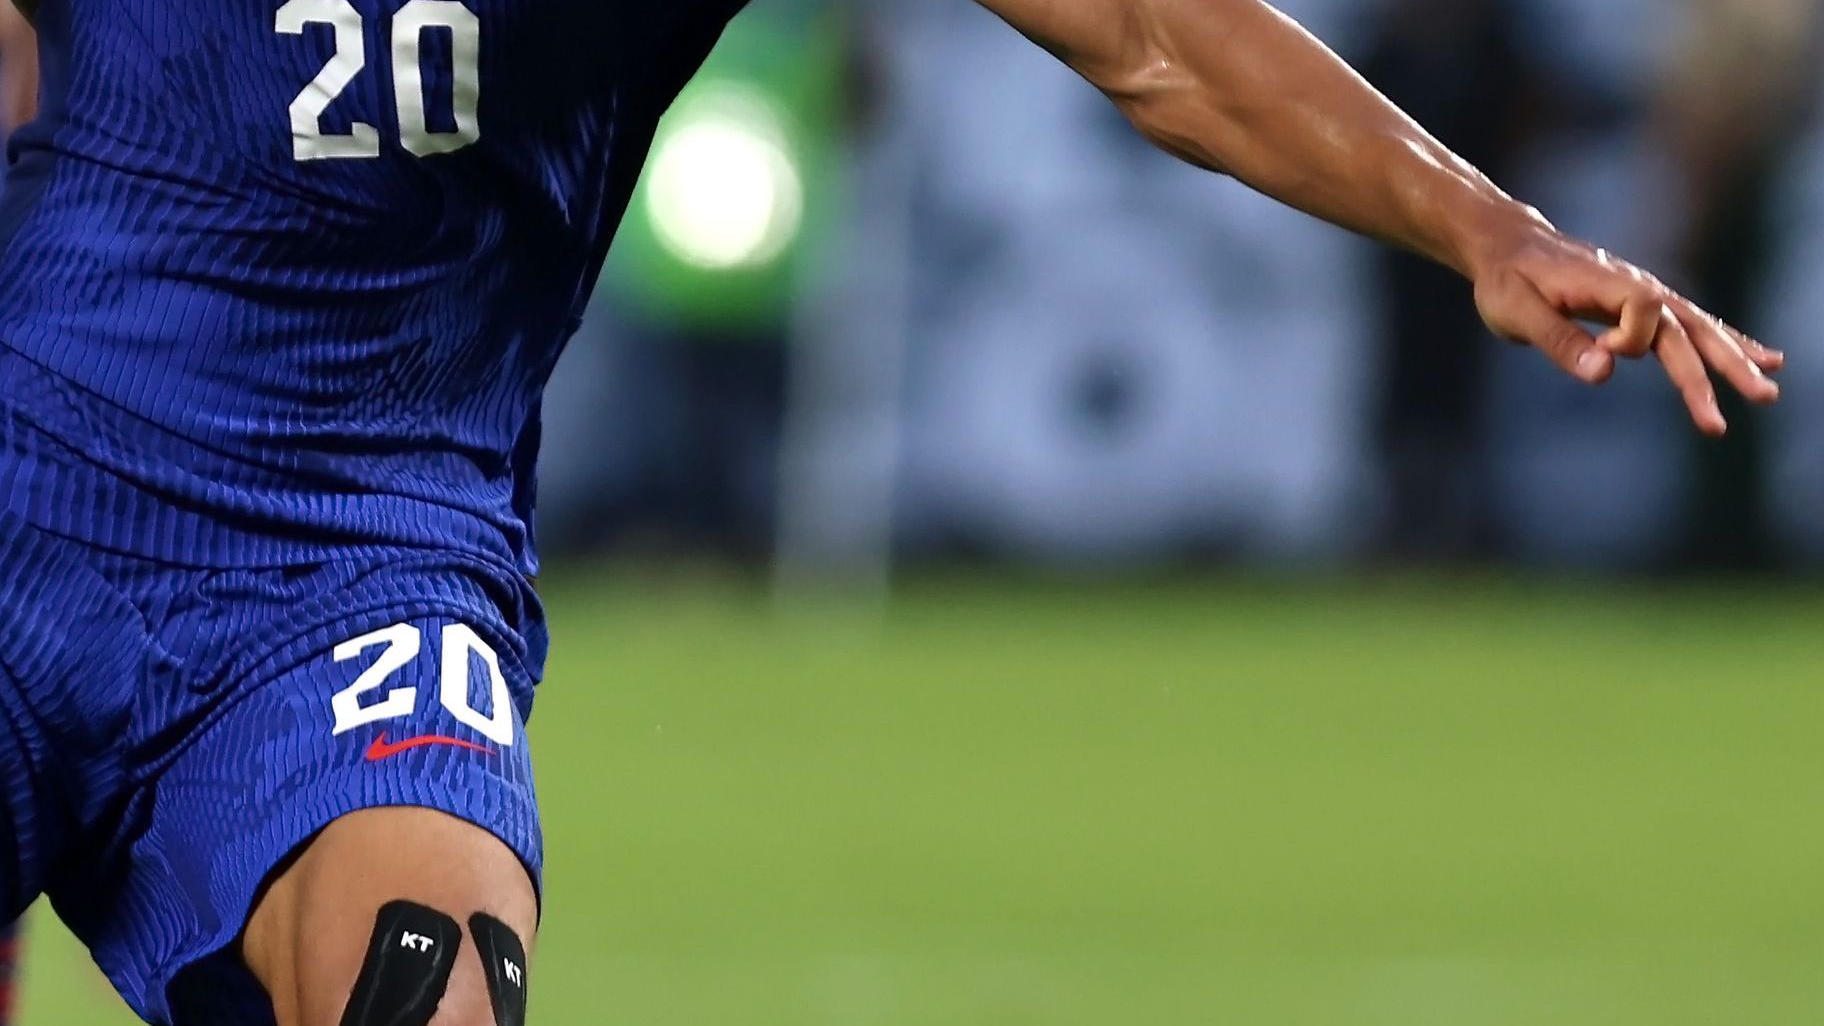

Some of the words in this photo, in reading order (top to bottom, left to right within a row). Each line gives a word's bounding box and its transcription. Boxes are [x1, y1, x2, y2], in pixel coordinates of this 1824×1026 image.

[331, 621, 514, 747] 20
[400, 930, 435, 953] KT
[503, 957, 523, 988] KT
